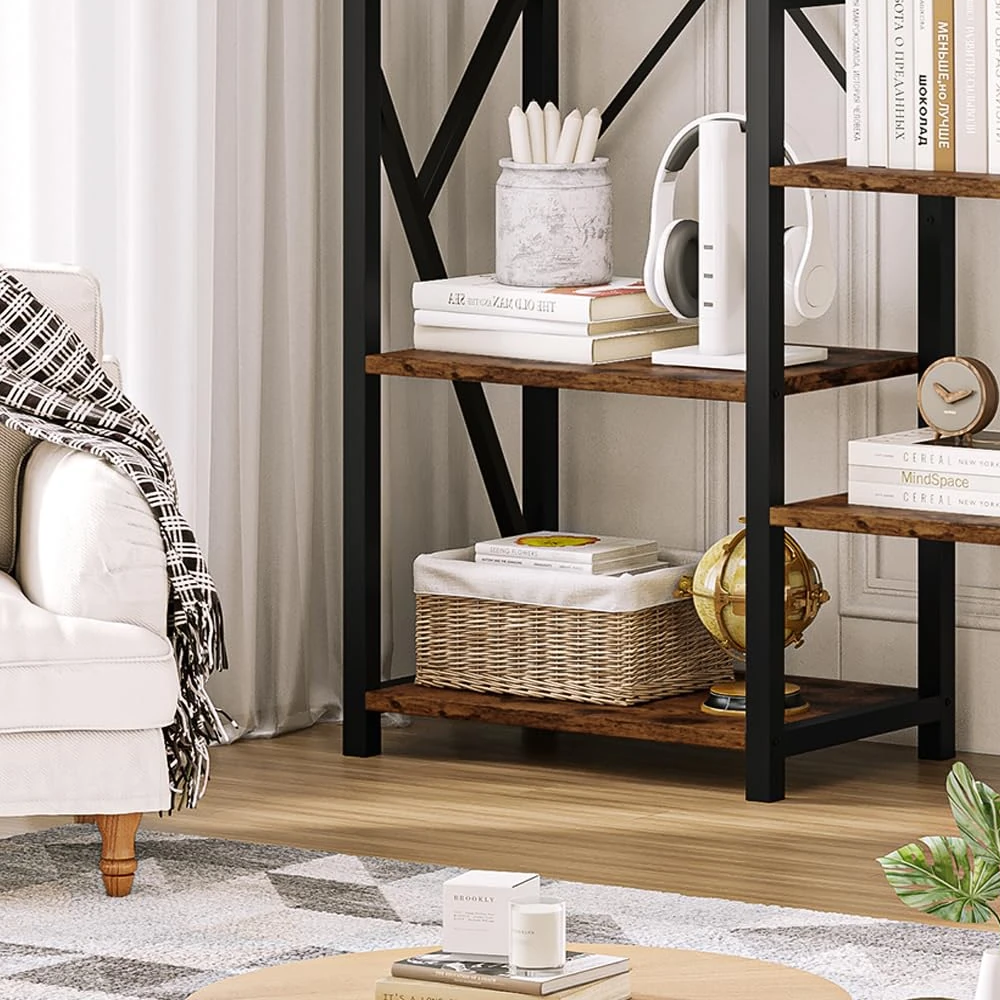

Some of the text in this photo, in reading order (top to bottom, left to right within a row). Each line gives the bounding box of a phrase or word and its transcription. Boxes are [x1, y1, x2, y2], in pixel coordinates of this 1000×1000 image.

[894, 36, 904, 47] О
[893, 51, 905, 140] ПРЕДАННЫХ
[918, 74, 928, 146] ШОКОЛАД
[938, 102, 950, 149] ЛУЧШЕ
[903, 451, 952, 466] CEREAL
[979, 460, 1000, 468] YORK
[901, 471, 970, 489] MindSpace
[903, 491, 953, 506] CEREAL
[979, 500, 1000, 508] YORK
